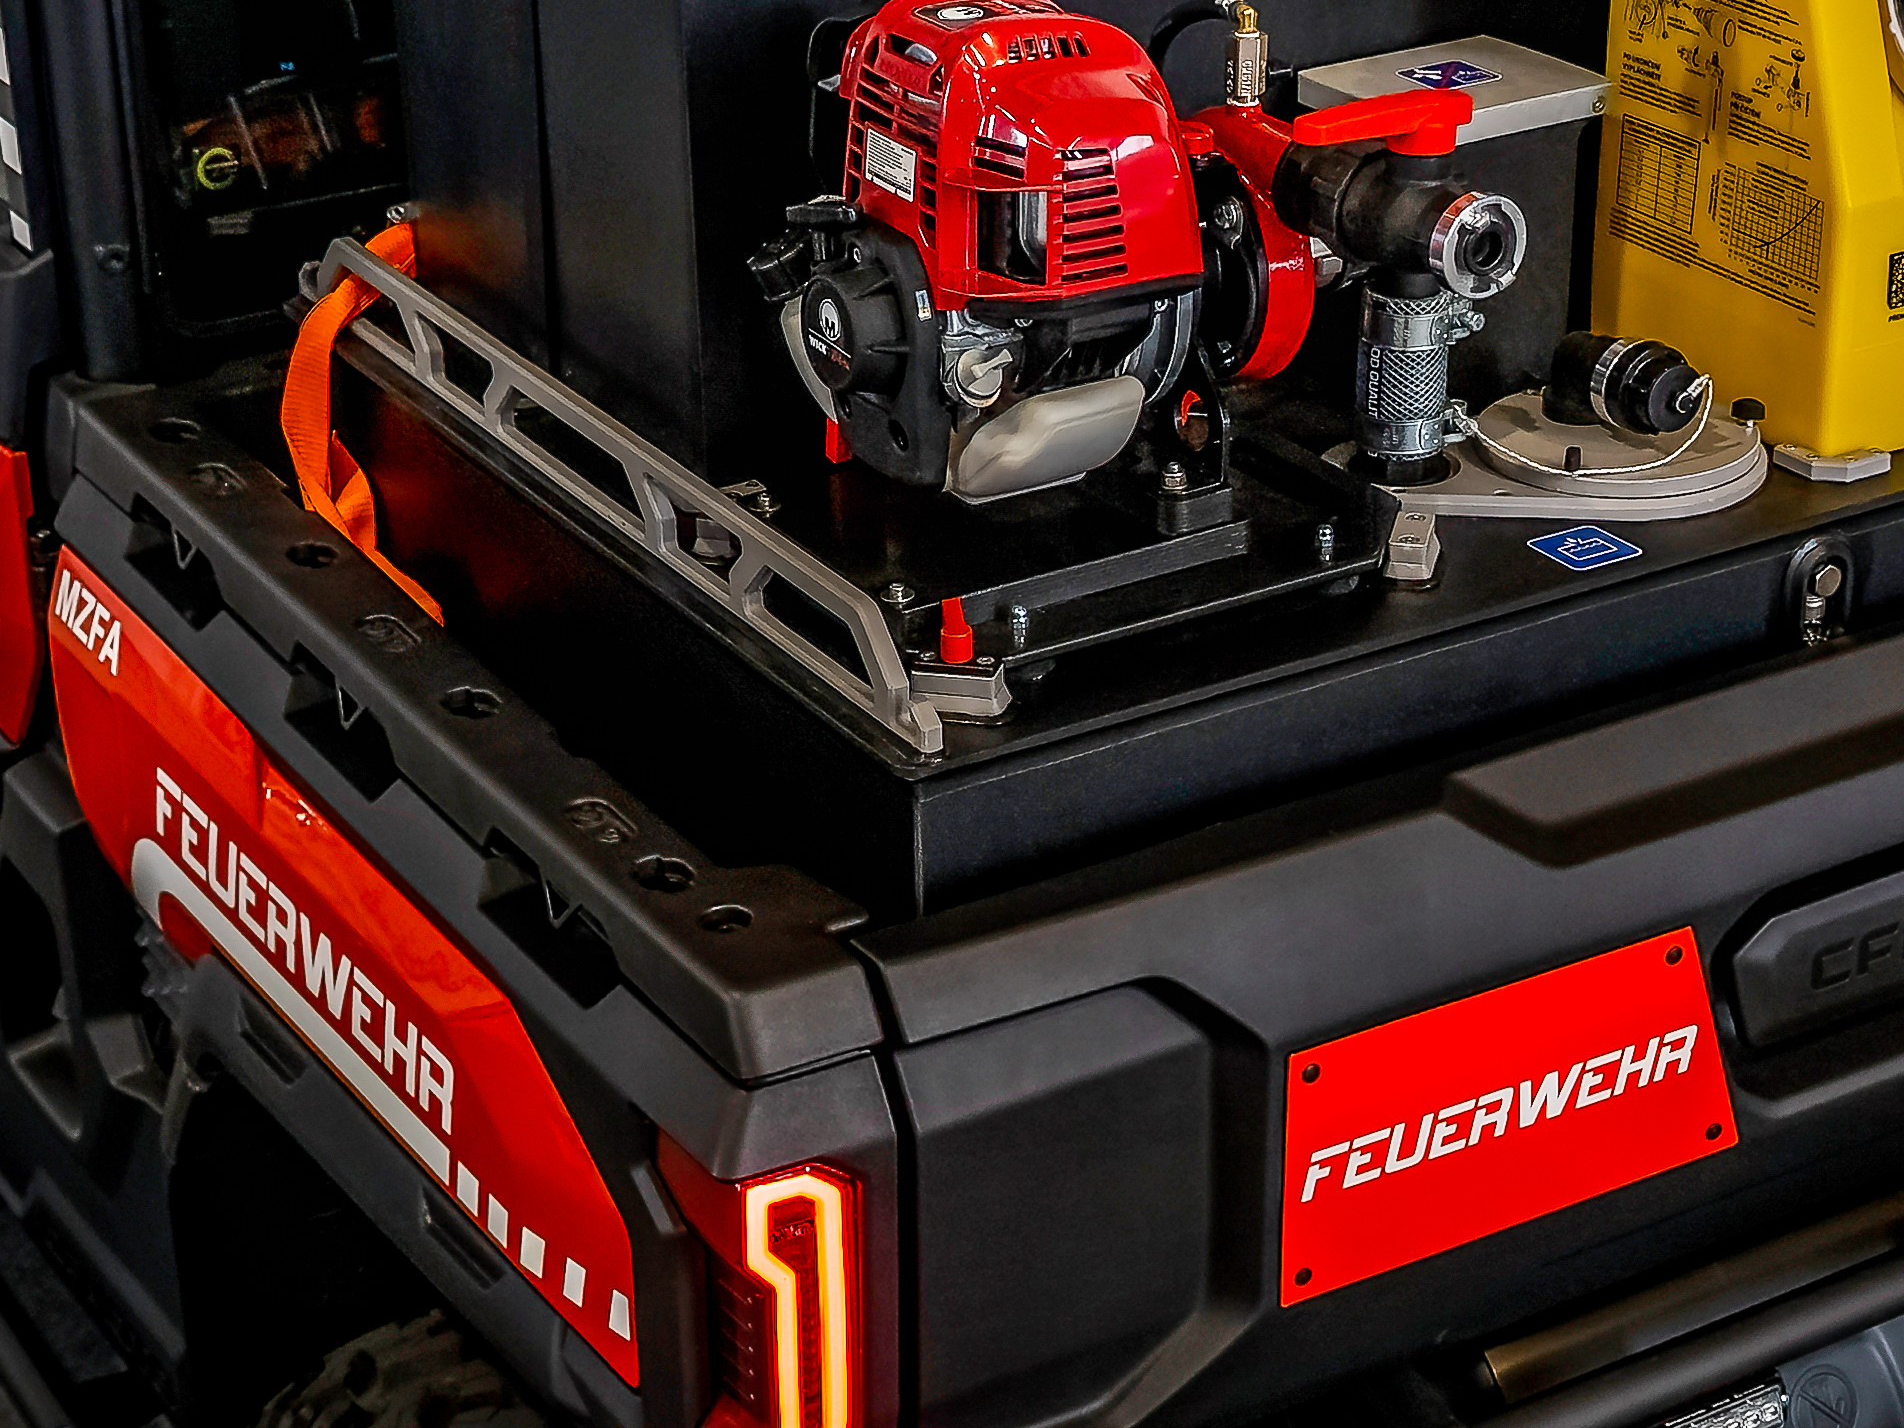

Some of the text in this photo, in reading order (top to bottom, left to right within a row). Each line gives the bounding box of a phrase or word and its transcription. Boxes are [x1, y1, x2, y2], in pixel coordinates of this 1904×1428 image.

[1368, 371, 1379, 420] QUALIT
[55, 569, 121, 676] MZFA
[156, 767, 455, 1134] FEUERWEHR
[1300, 1024, 1698, 1203] FEUERWEHR
